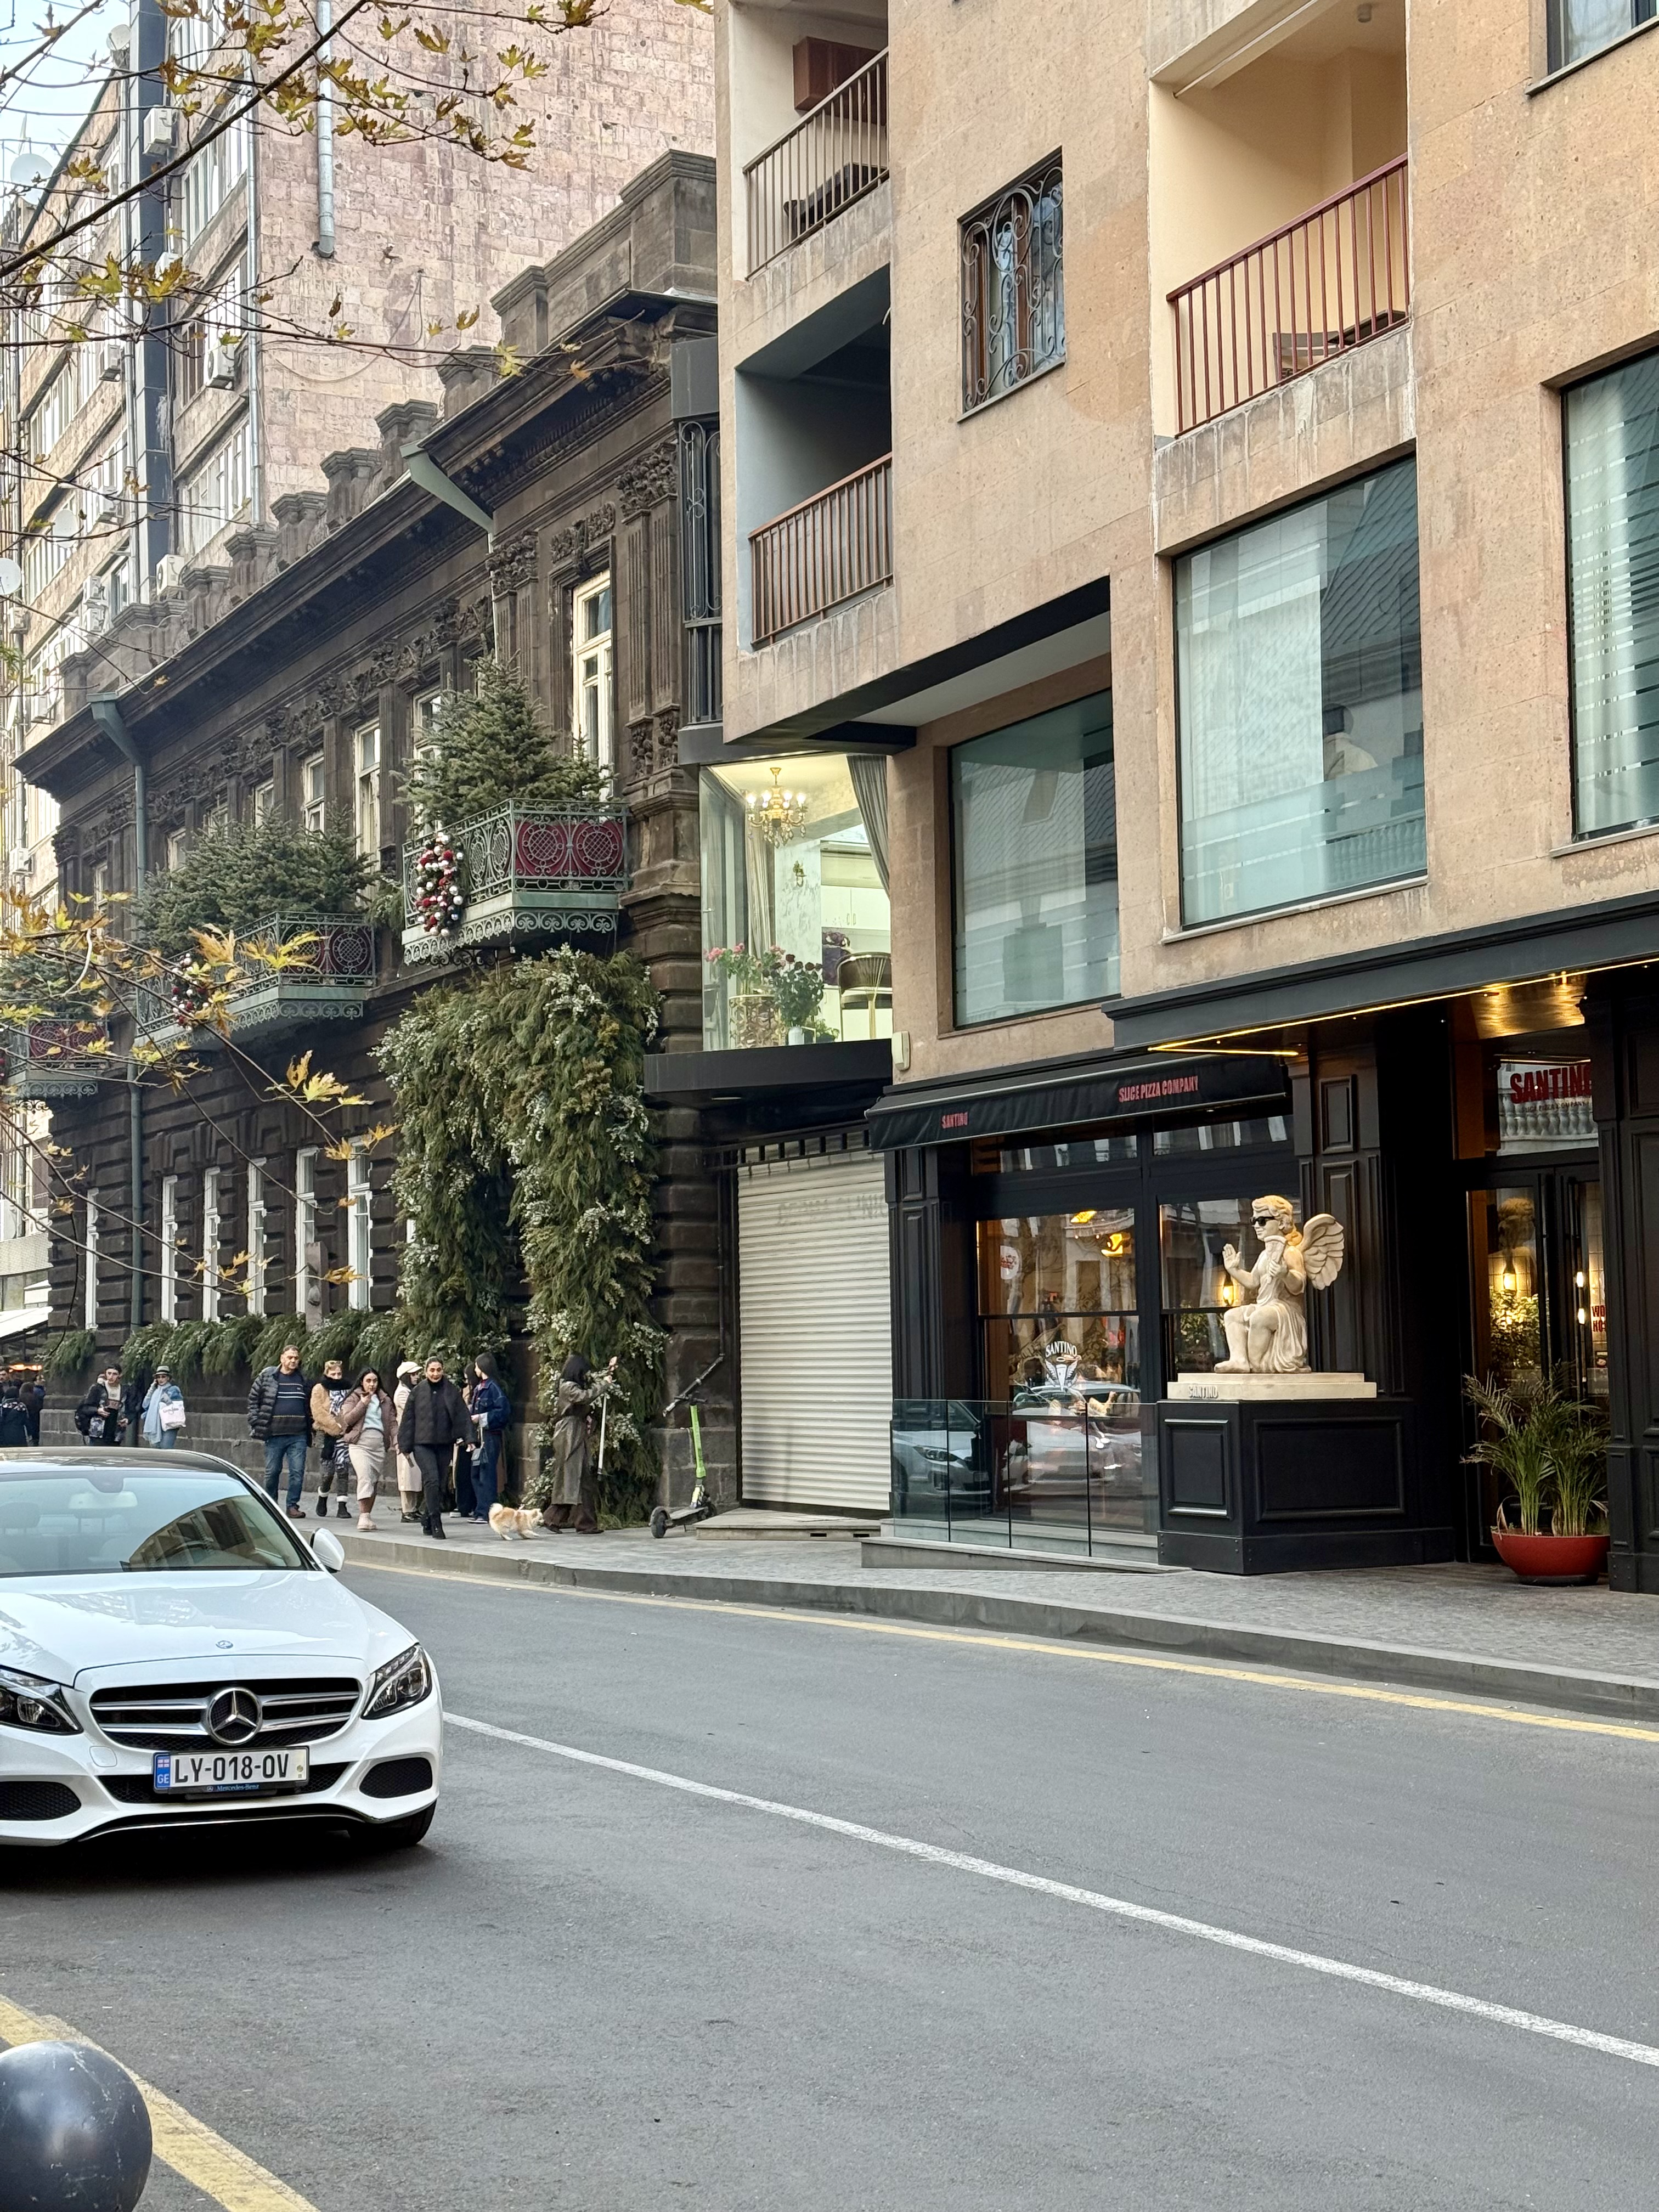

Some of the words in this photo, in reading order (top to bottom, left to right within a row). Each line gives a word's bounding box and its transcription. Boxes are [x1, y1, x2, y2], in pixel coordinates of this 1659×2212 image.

[1119, 1085, 1139, 1103] SLICE
[1141, 1082, 1161, 1099] PIZZA
[1162, 1075, 1199, 1095] COMPANY
[941, 1111, 968, 1129] SANTINO
[1045, 1341, 1077, 1358] SANTINO
[1188, 1384, 1219, 1399] SANTINO
[157, 1774, 169, 1784] GE
